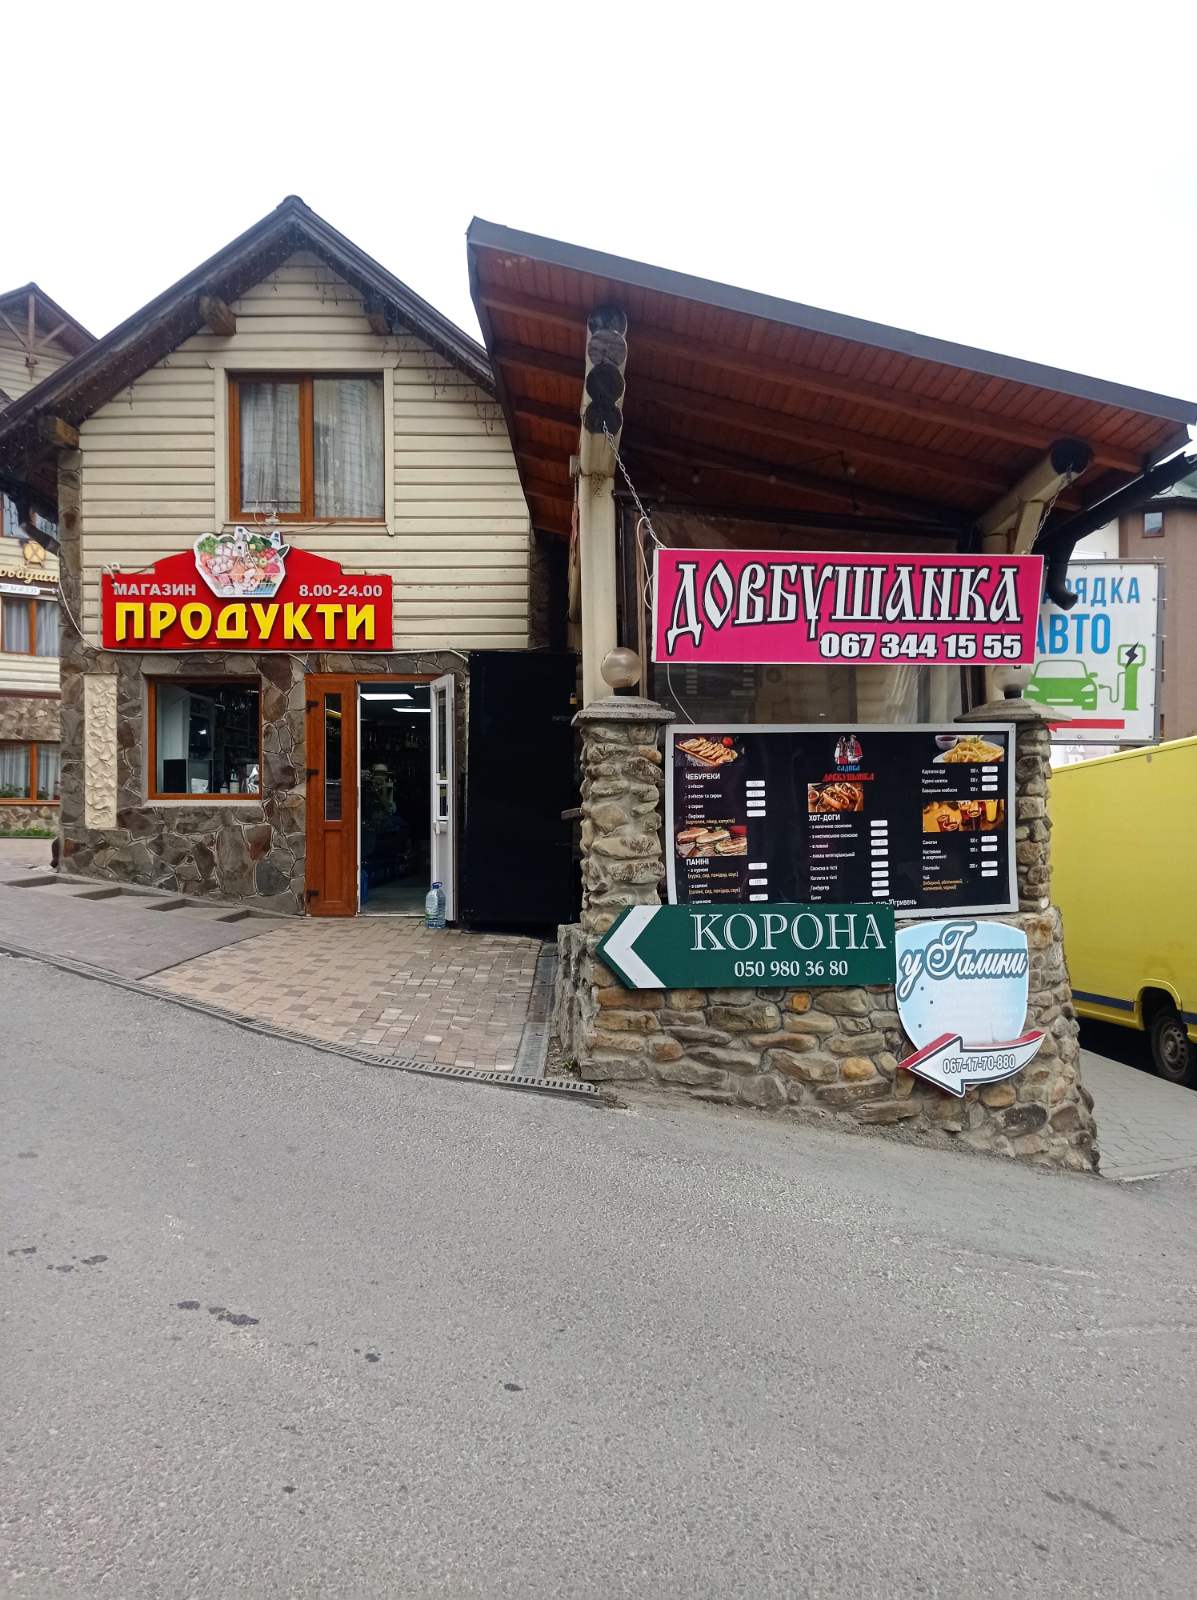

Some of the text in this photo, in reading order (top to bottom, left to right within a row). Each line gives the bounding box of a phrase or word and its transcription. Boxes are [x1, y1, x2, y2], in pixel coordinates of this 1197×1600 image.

[113, 583, 383, 597] МАГАЗИН 8.00-24.00
[1042, 577, 1141, 607] ЯДКА
[666, 560, 1022, 656] ДОВБУШАНКА
[115, 602, 375, 641] ПРОДУКТИ
[819, 633, 1022, 658] 067 344 15 55
[808, 814, 841, 822] ХОТ-ДОГИ
[686, 858, 709, 866] ПАНІНІ
[689, 913, 886, 951] КОРОНА
[926, 922, 1028, 978] Галини
[734, 960, 848, 977] 050 980 36 80
[943, 1054, 1016, 1074] 067-17-70-880
